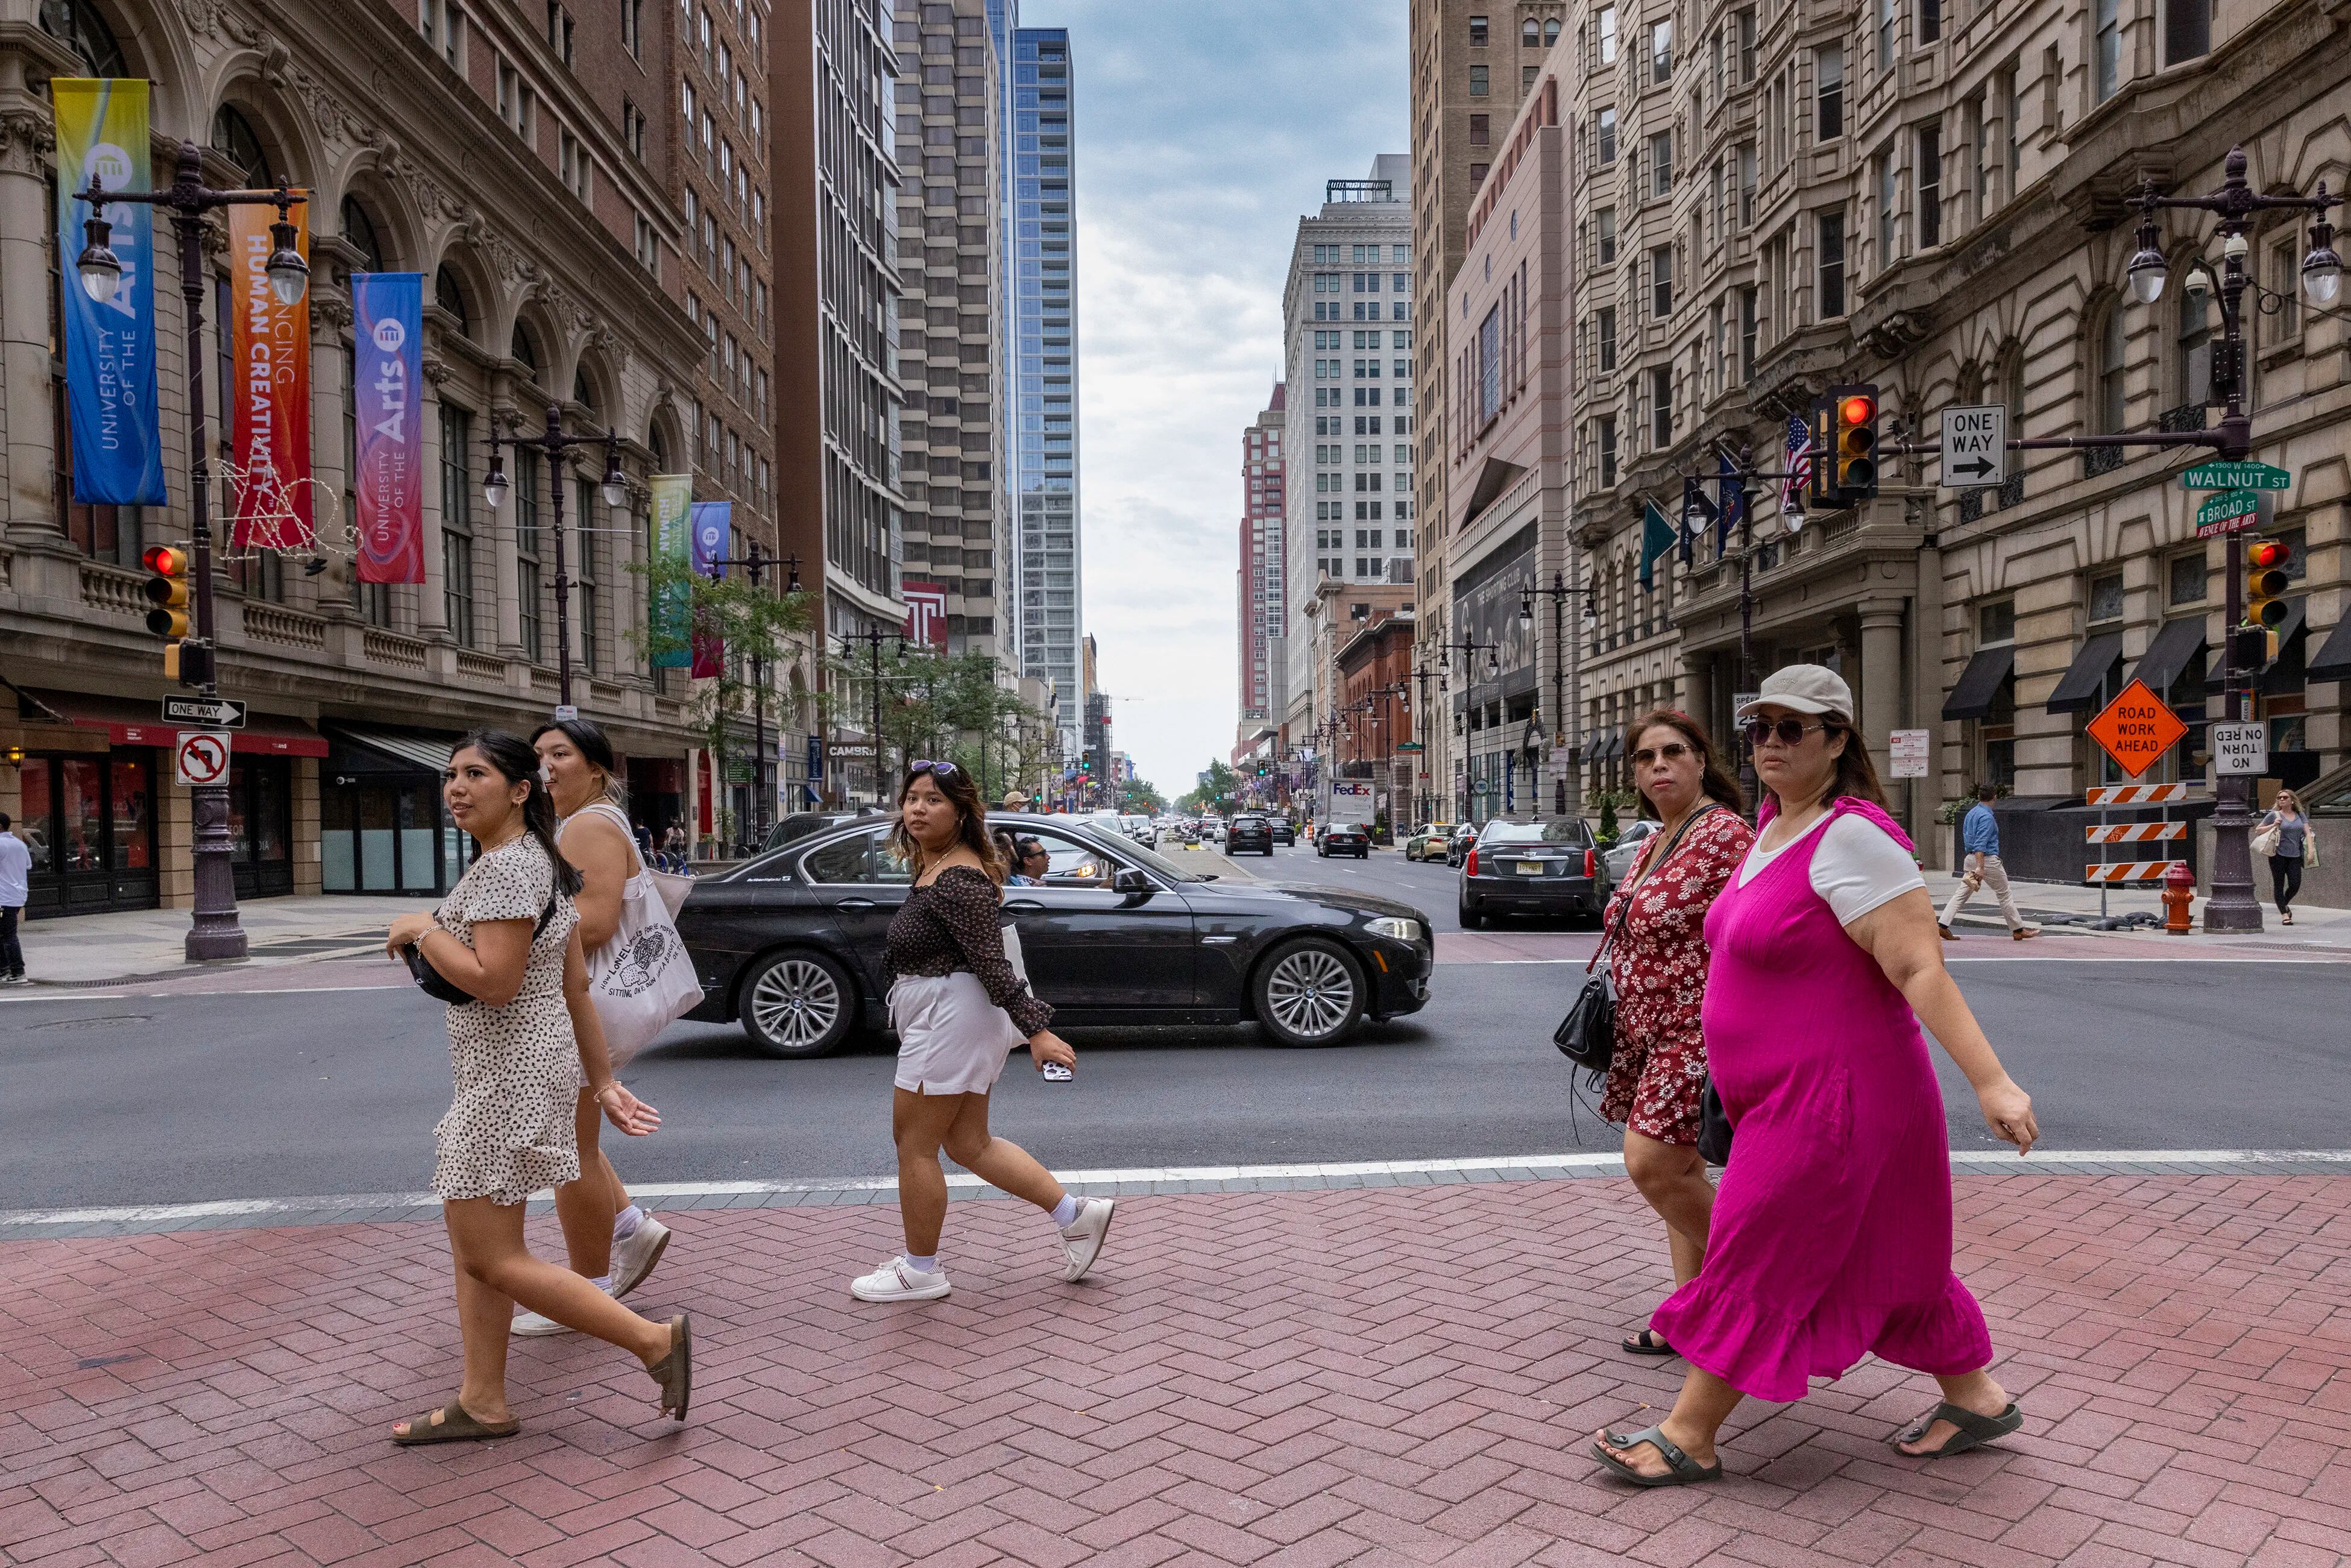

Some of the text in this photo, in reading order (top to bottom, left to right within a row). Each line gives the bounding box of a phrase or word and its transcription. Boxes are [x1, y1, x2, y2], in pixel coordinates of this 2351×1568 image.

[247, 236, 269, 333] HUMAN
[122, 330, 136, 406] OF THE
[100, 327, 119, 450] UNIVERSITY
[373, 361, 405, 444] Arts
[1954, 414, 1992, 432] ONE
[1953, 434, 1994, 453] WAY
[394, 452, 404, 509] OF THE
[2188, 472, 2286, 487] WALNUT ST
[378, 450, 389, 541] UNIVERSITY
[2207, 499, 2256, 522] BROAD ST
[659, 499, 670, 551] HUMAN
[2197, 512, 2256, 538] AVENUE OF THE ARTS
[1485, 576, 1507, 602] SPORTING
[1507, 567, 1520, 588] CLUB
[172, 704, 220, 717] ONE WAY
[2118, 707, 2156, 719] ROAD
[2118, 724, 2156, 735] WORK
[2216, 729, 2262, 741] ON RED
[2115, 740, 2158, 752] AHEAD
[2223, 743, 2257, 754] TURN
[2232, 758, 2250, 768] NO
[1333, 783, 1370, 795] FedEx
[600, 974, 611, 990] HOW
[644, 925, 653, 935] FOR
[673, 951, 679, 960] OR
[608, 988, 632, 998] SITTING
[646, 977, 656, 989] OWN
[661, 962, 667, 971] A
[664, 938, 677, 964] BISCUIT
